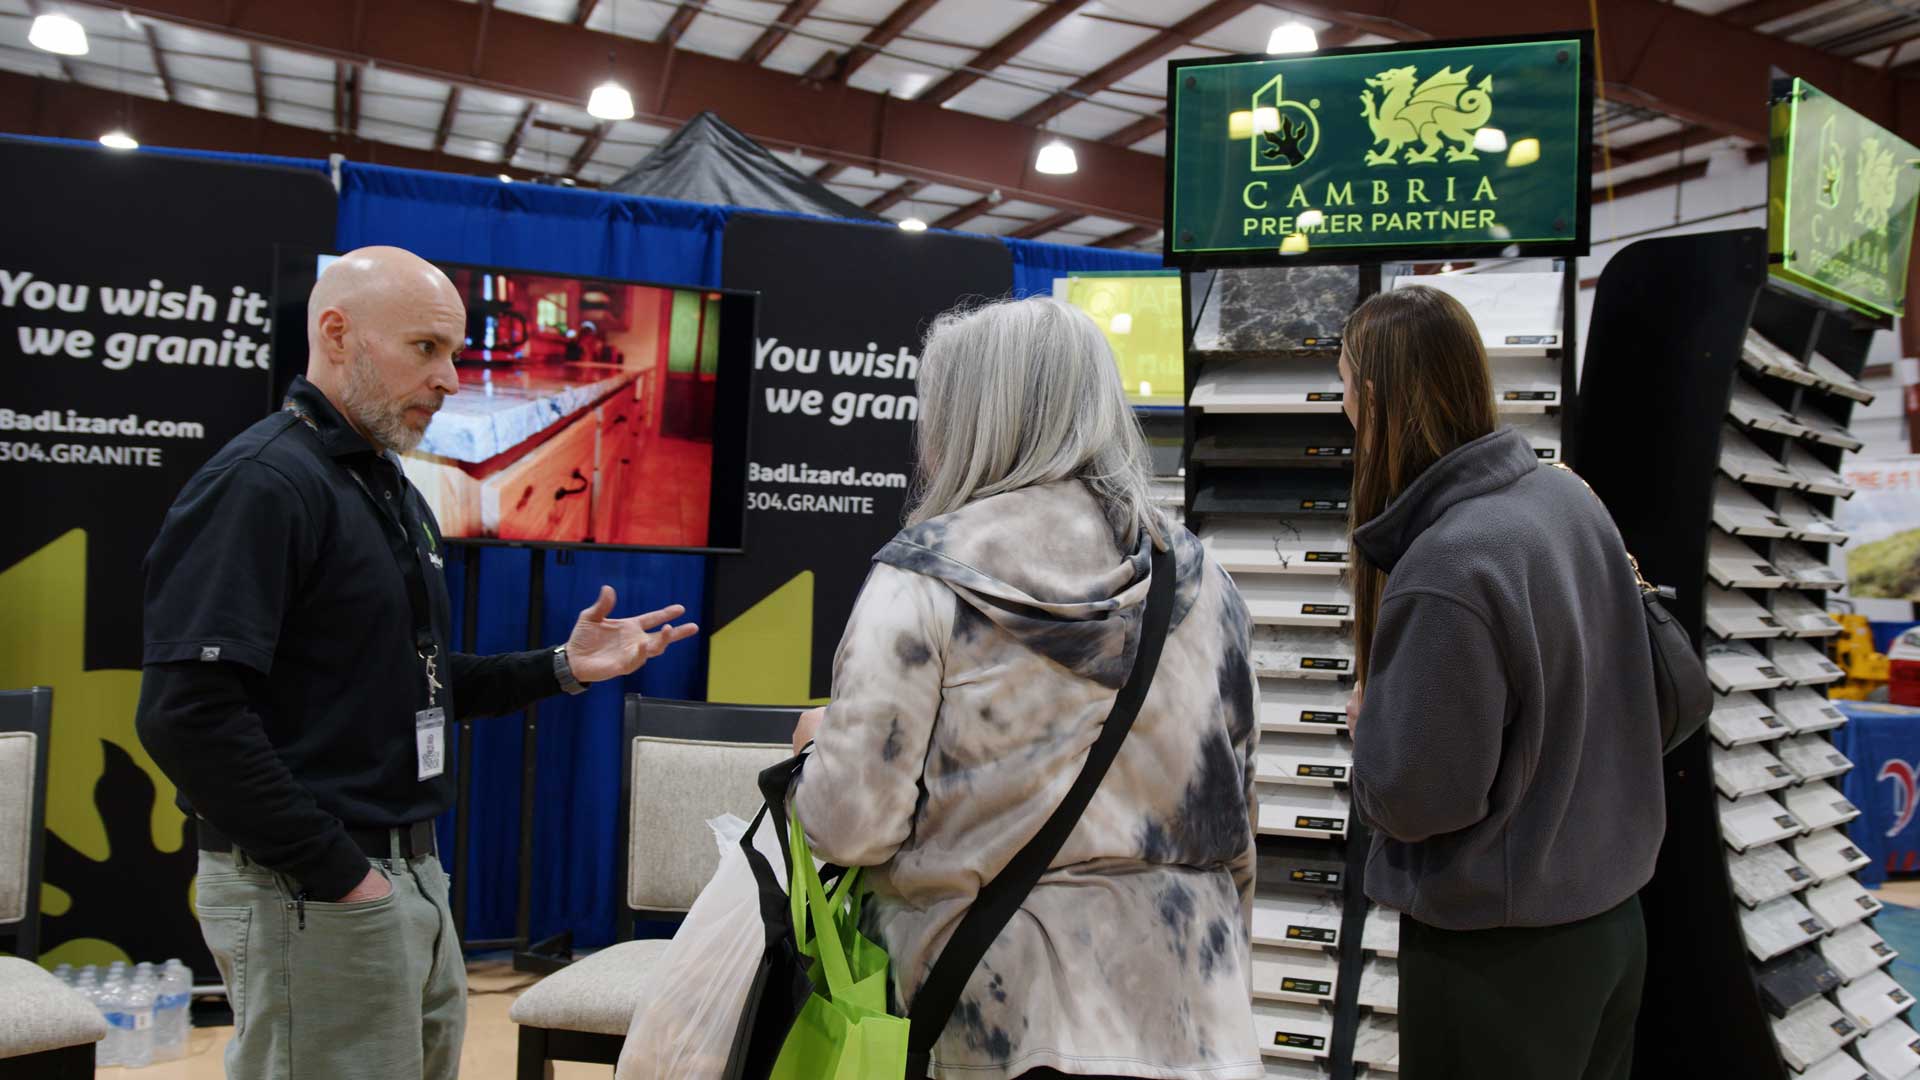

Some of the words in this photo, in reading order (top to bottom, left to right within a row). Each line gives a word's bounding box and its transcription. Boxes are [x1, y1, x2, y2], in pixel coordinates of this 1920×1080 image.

[1242, 175, 1498, 210] CAMBRIA
[1371, 209, 1496, 232] PARTNER
[0, 269, 90, 313] You
[100, 279, 217, 322] wish
[226, 285, 272, 333] it,
[18, 326, 95, 358] we
[754, 337, 821, 374] You
[829, 342, 919, 380] wish
[765, 387, 824, 416] we
[0, 408, 205, 439] BadLizard.com
[0, 441, 163, 468] 304.GRANITE
[748, 462, 907, 489] BadLizard.com
[747, 492, 874, 514] 304.GRANITE
